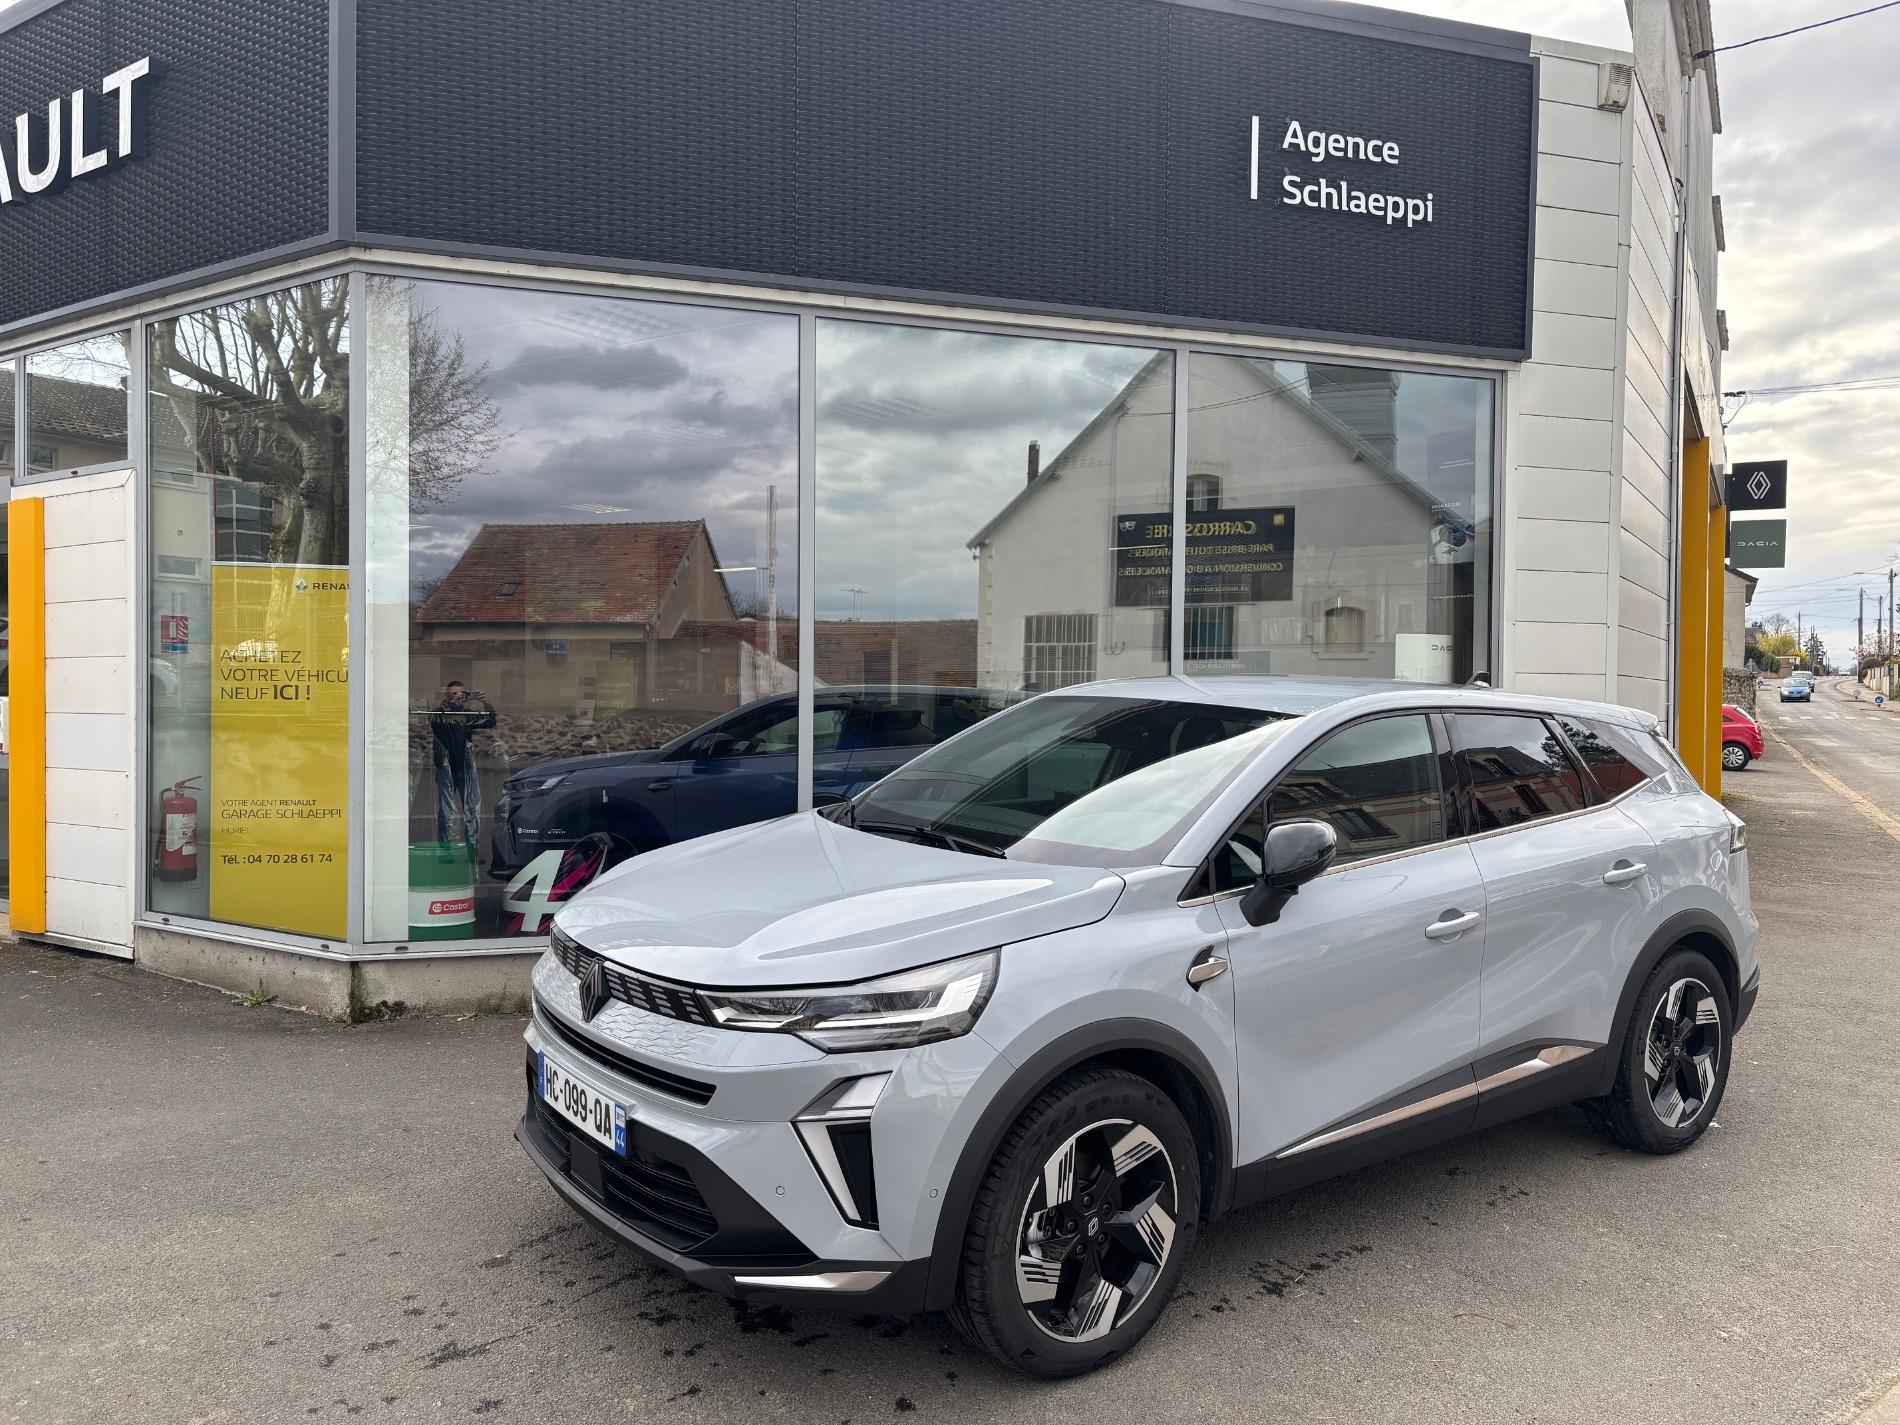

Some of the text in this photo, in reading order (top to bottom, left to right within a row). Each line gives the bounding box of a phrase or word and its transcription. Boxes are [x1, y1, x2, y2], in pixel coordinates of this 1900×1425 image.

[1282, 120, 1400, 164] Agence
[1282, 174, 1434, 228] Schlaeppi
[312, 582, 349, 591] RENA
[220, 649, 302, 664] ACHETEZ
[220, 668, 281, 682] VOTRE
[220, 686, 270, 700] NEUF
[272, 684, 299, 700] ICI
[221, 808, 342, 819] GARAGE SCHLAEPPI
[221, 827, 250, 835] HURIEL
[221, 854, 240, 865] Tél.
[266, 854, 281, 864] 70
[283, 854, 298, 864] 28
[300, 854, 314, 864] 61
[318, 853, 333, 864] 74
[443, 901, 469, 911] Castrol
[545, 1063, 612, 1140] HC-099-QA
[616, 1129, 625, 1148] 44
